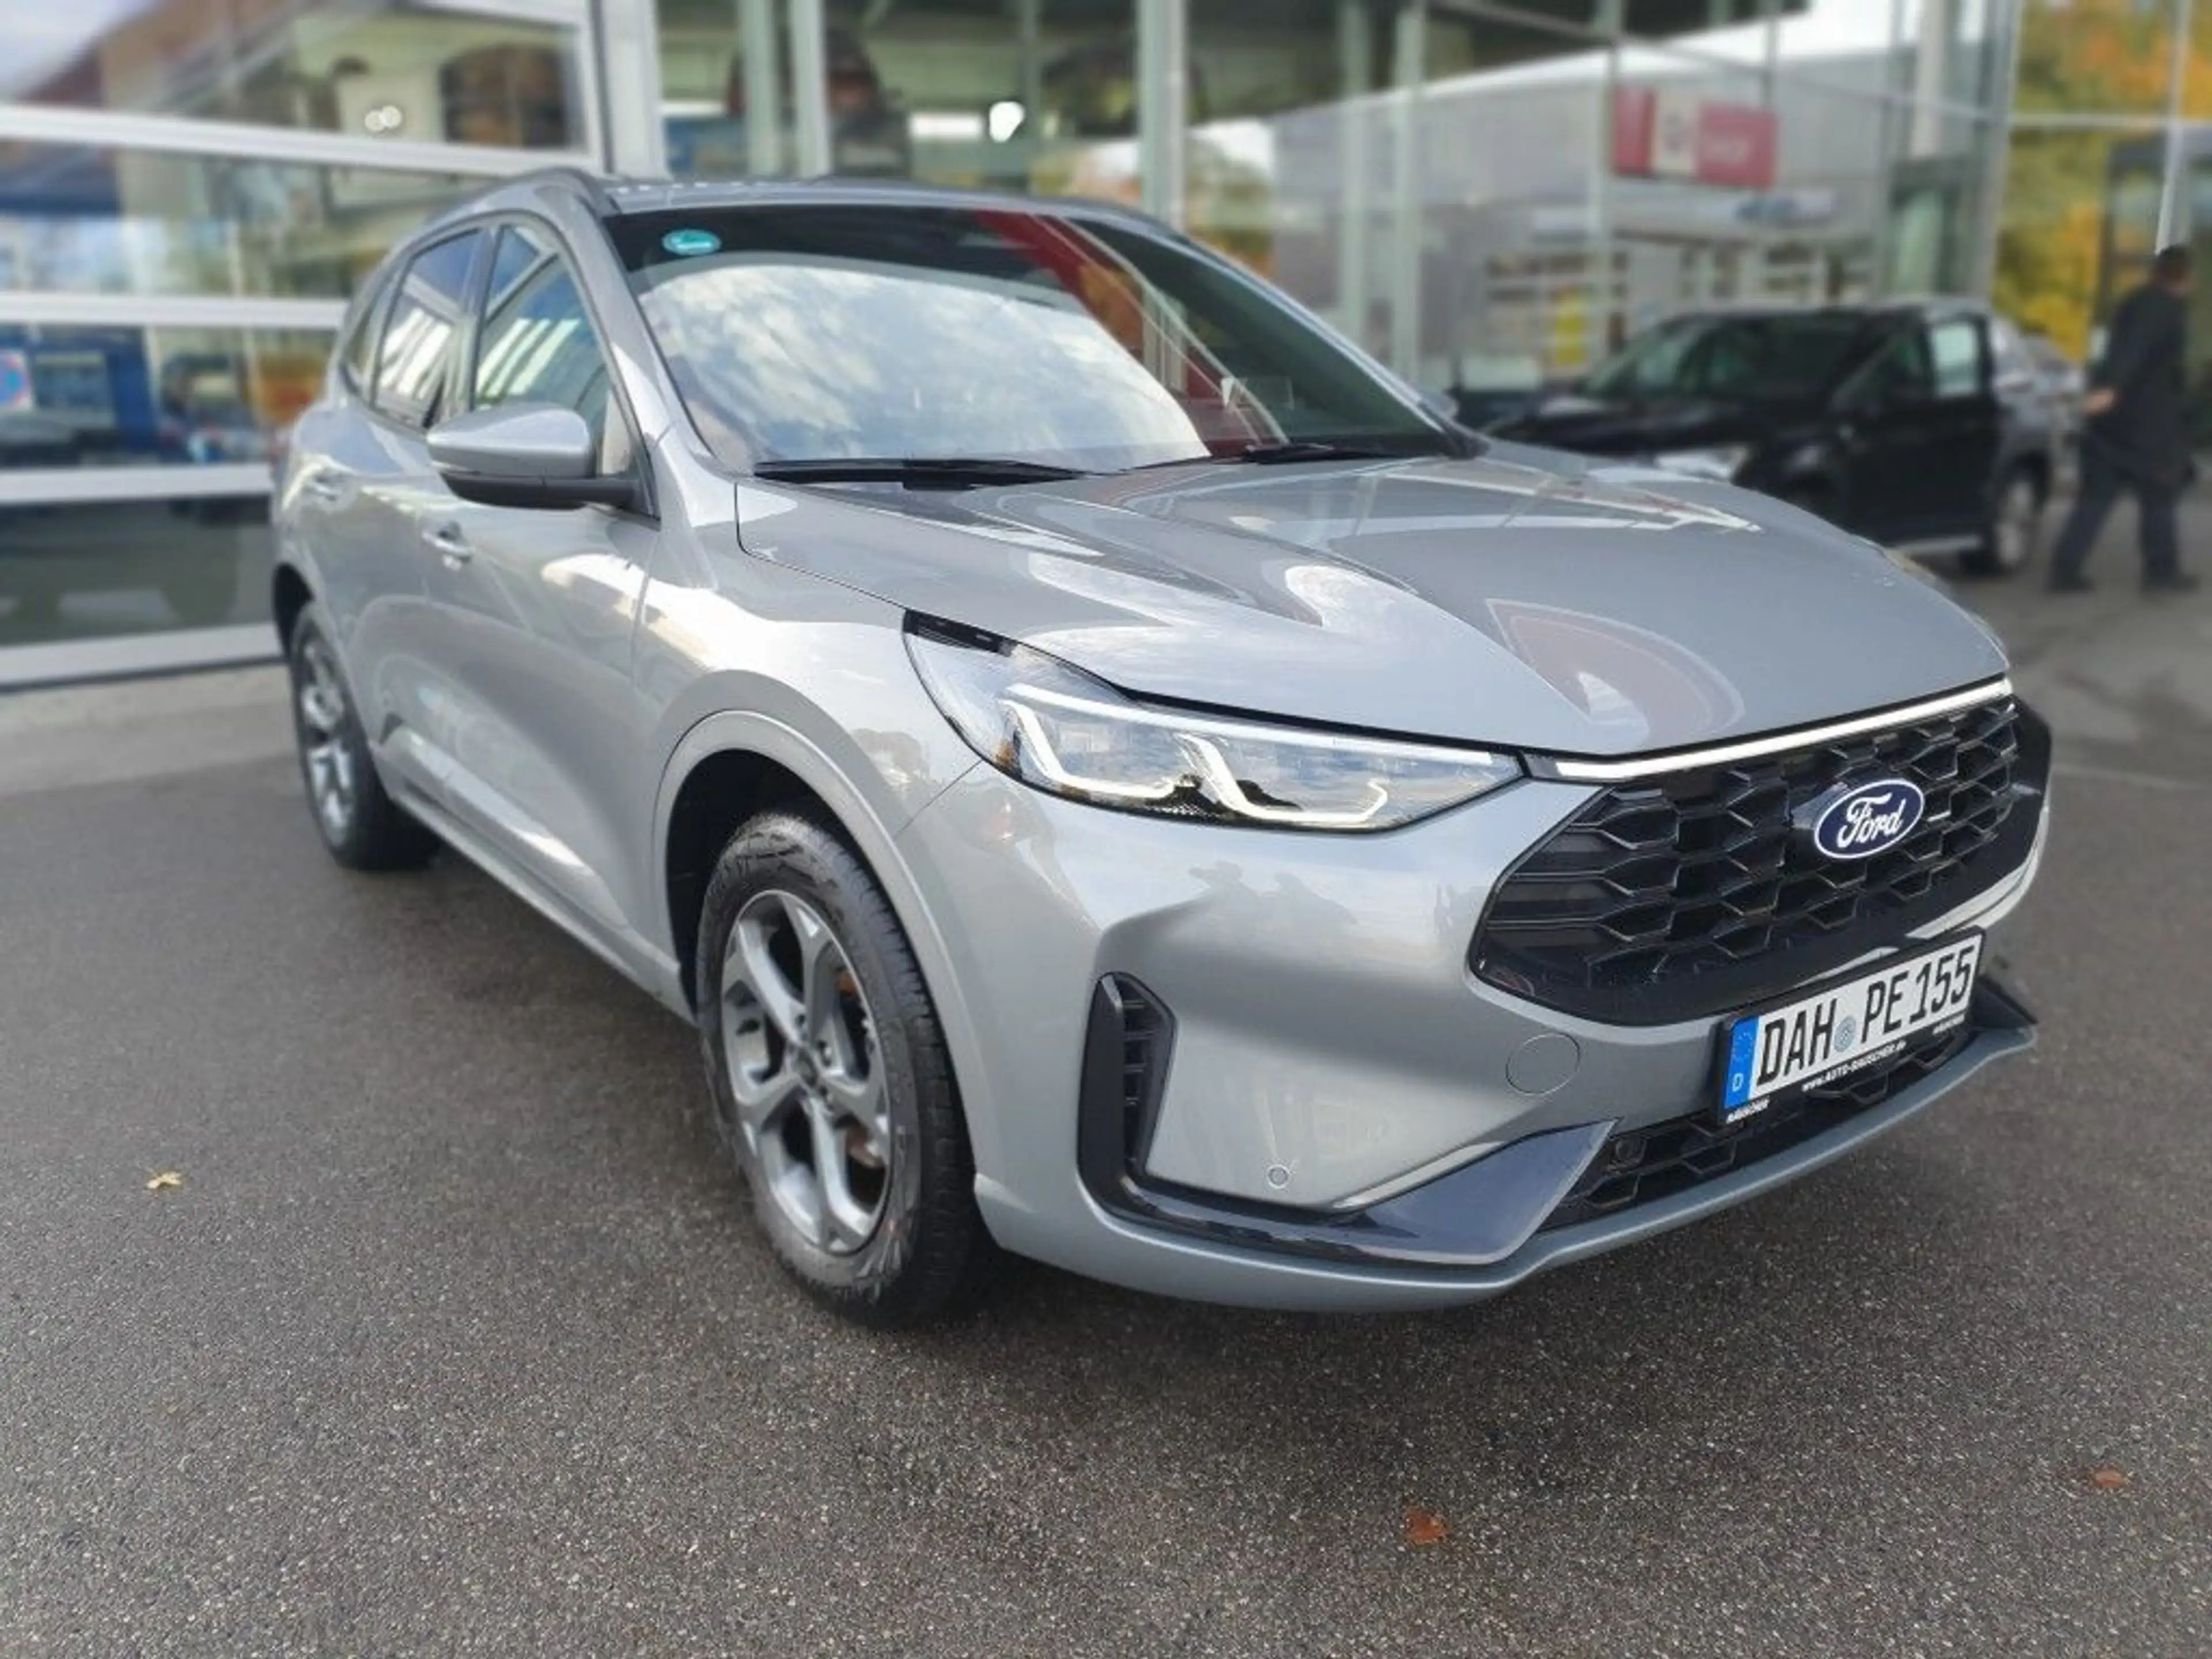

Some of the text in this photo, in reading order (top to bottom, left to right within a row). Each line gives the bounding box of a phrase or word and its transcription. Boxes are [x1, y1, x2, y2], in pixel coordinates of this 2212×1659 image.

[1836, 792, 1906, 848] Ford
[1757, 999, 1836, 1086] DAH
[1732, 1073, 1744, 1092] D
